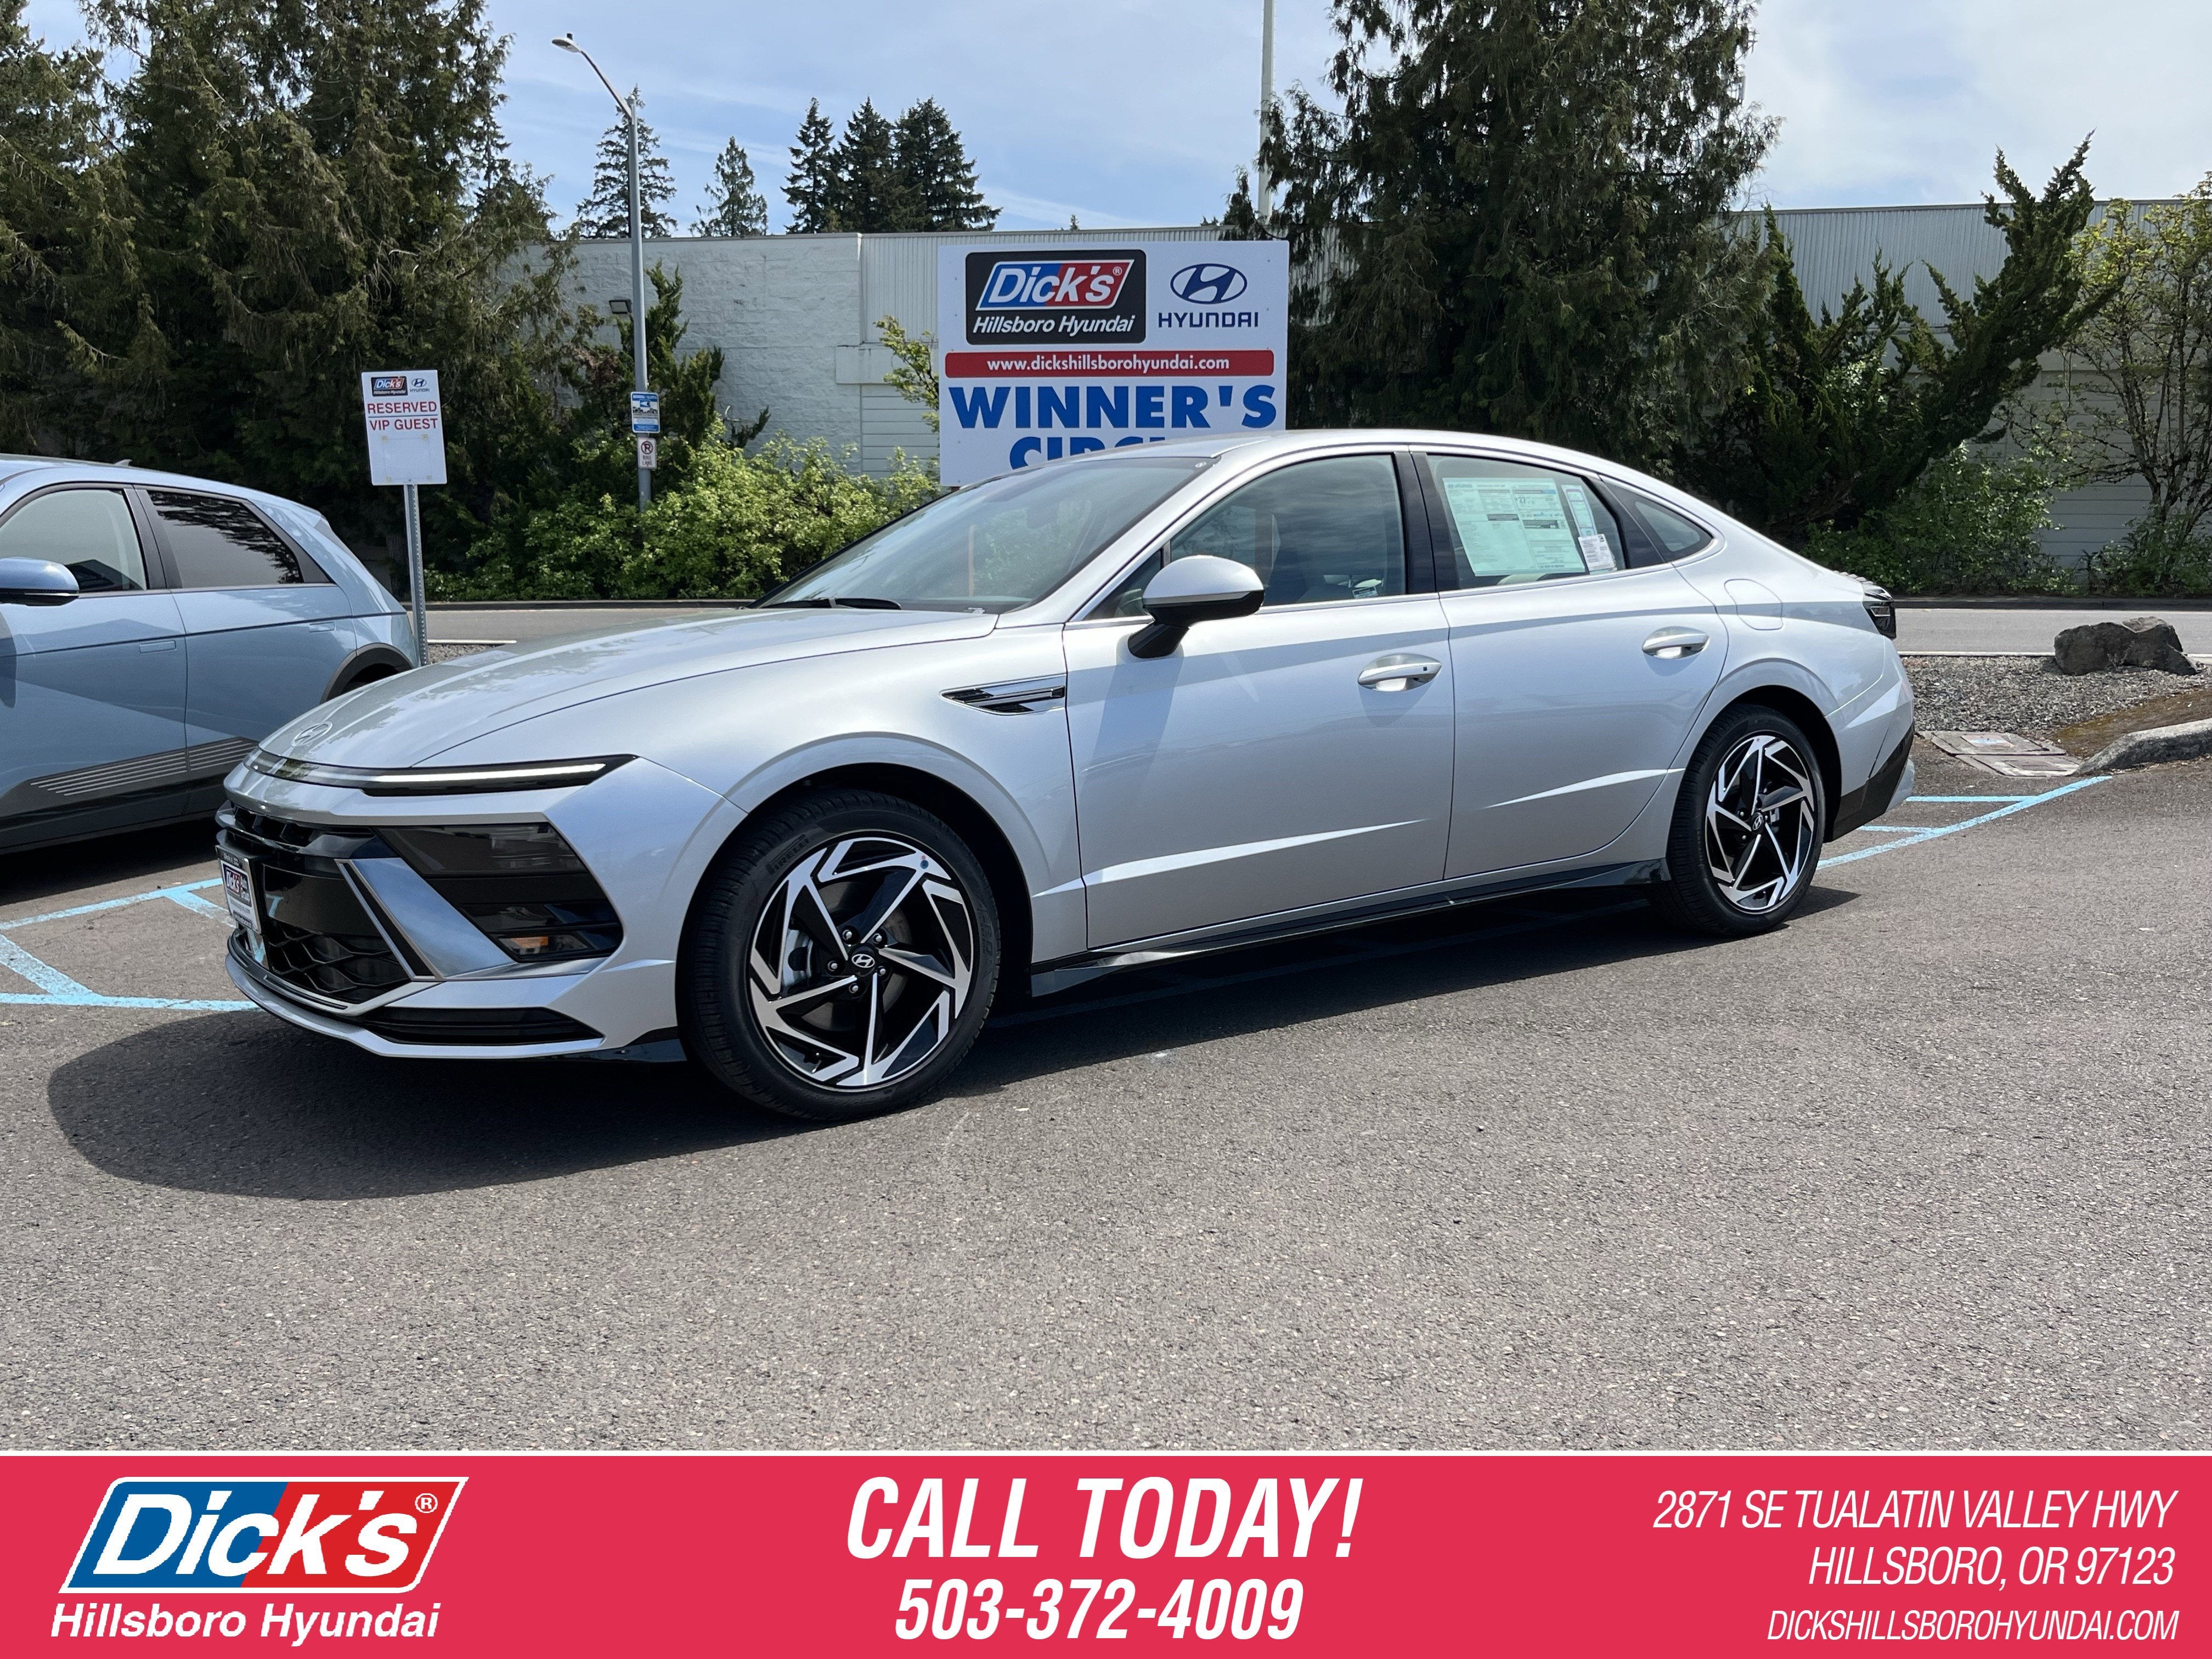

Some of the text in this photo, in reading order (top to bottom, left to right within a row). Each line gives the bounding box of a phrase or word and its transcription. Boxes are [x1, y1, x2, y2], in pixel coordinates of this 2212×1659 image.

[989, 264, 1114, 303] Dick's
[973, 315, 1136, 337] Hillsboro Hyundai
[1158, 311, 1259, 329] HYUNDAI
[986, 353, 1230, 374] www.dickshillsborohyundai.com
[367, 401, 437, 414] RESERVED
[947, 384, 1277, 430] WINNER'S
[369, 417, 438, 431] VIP GUEST
